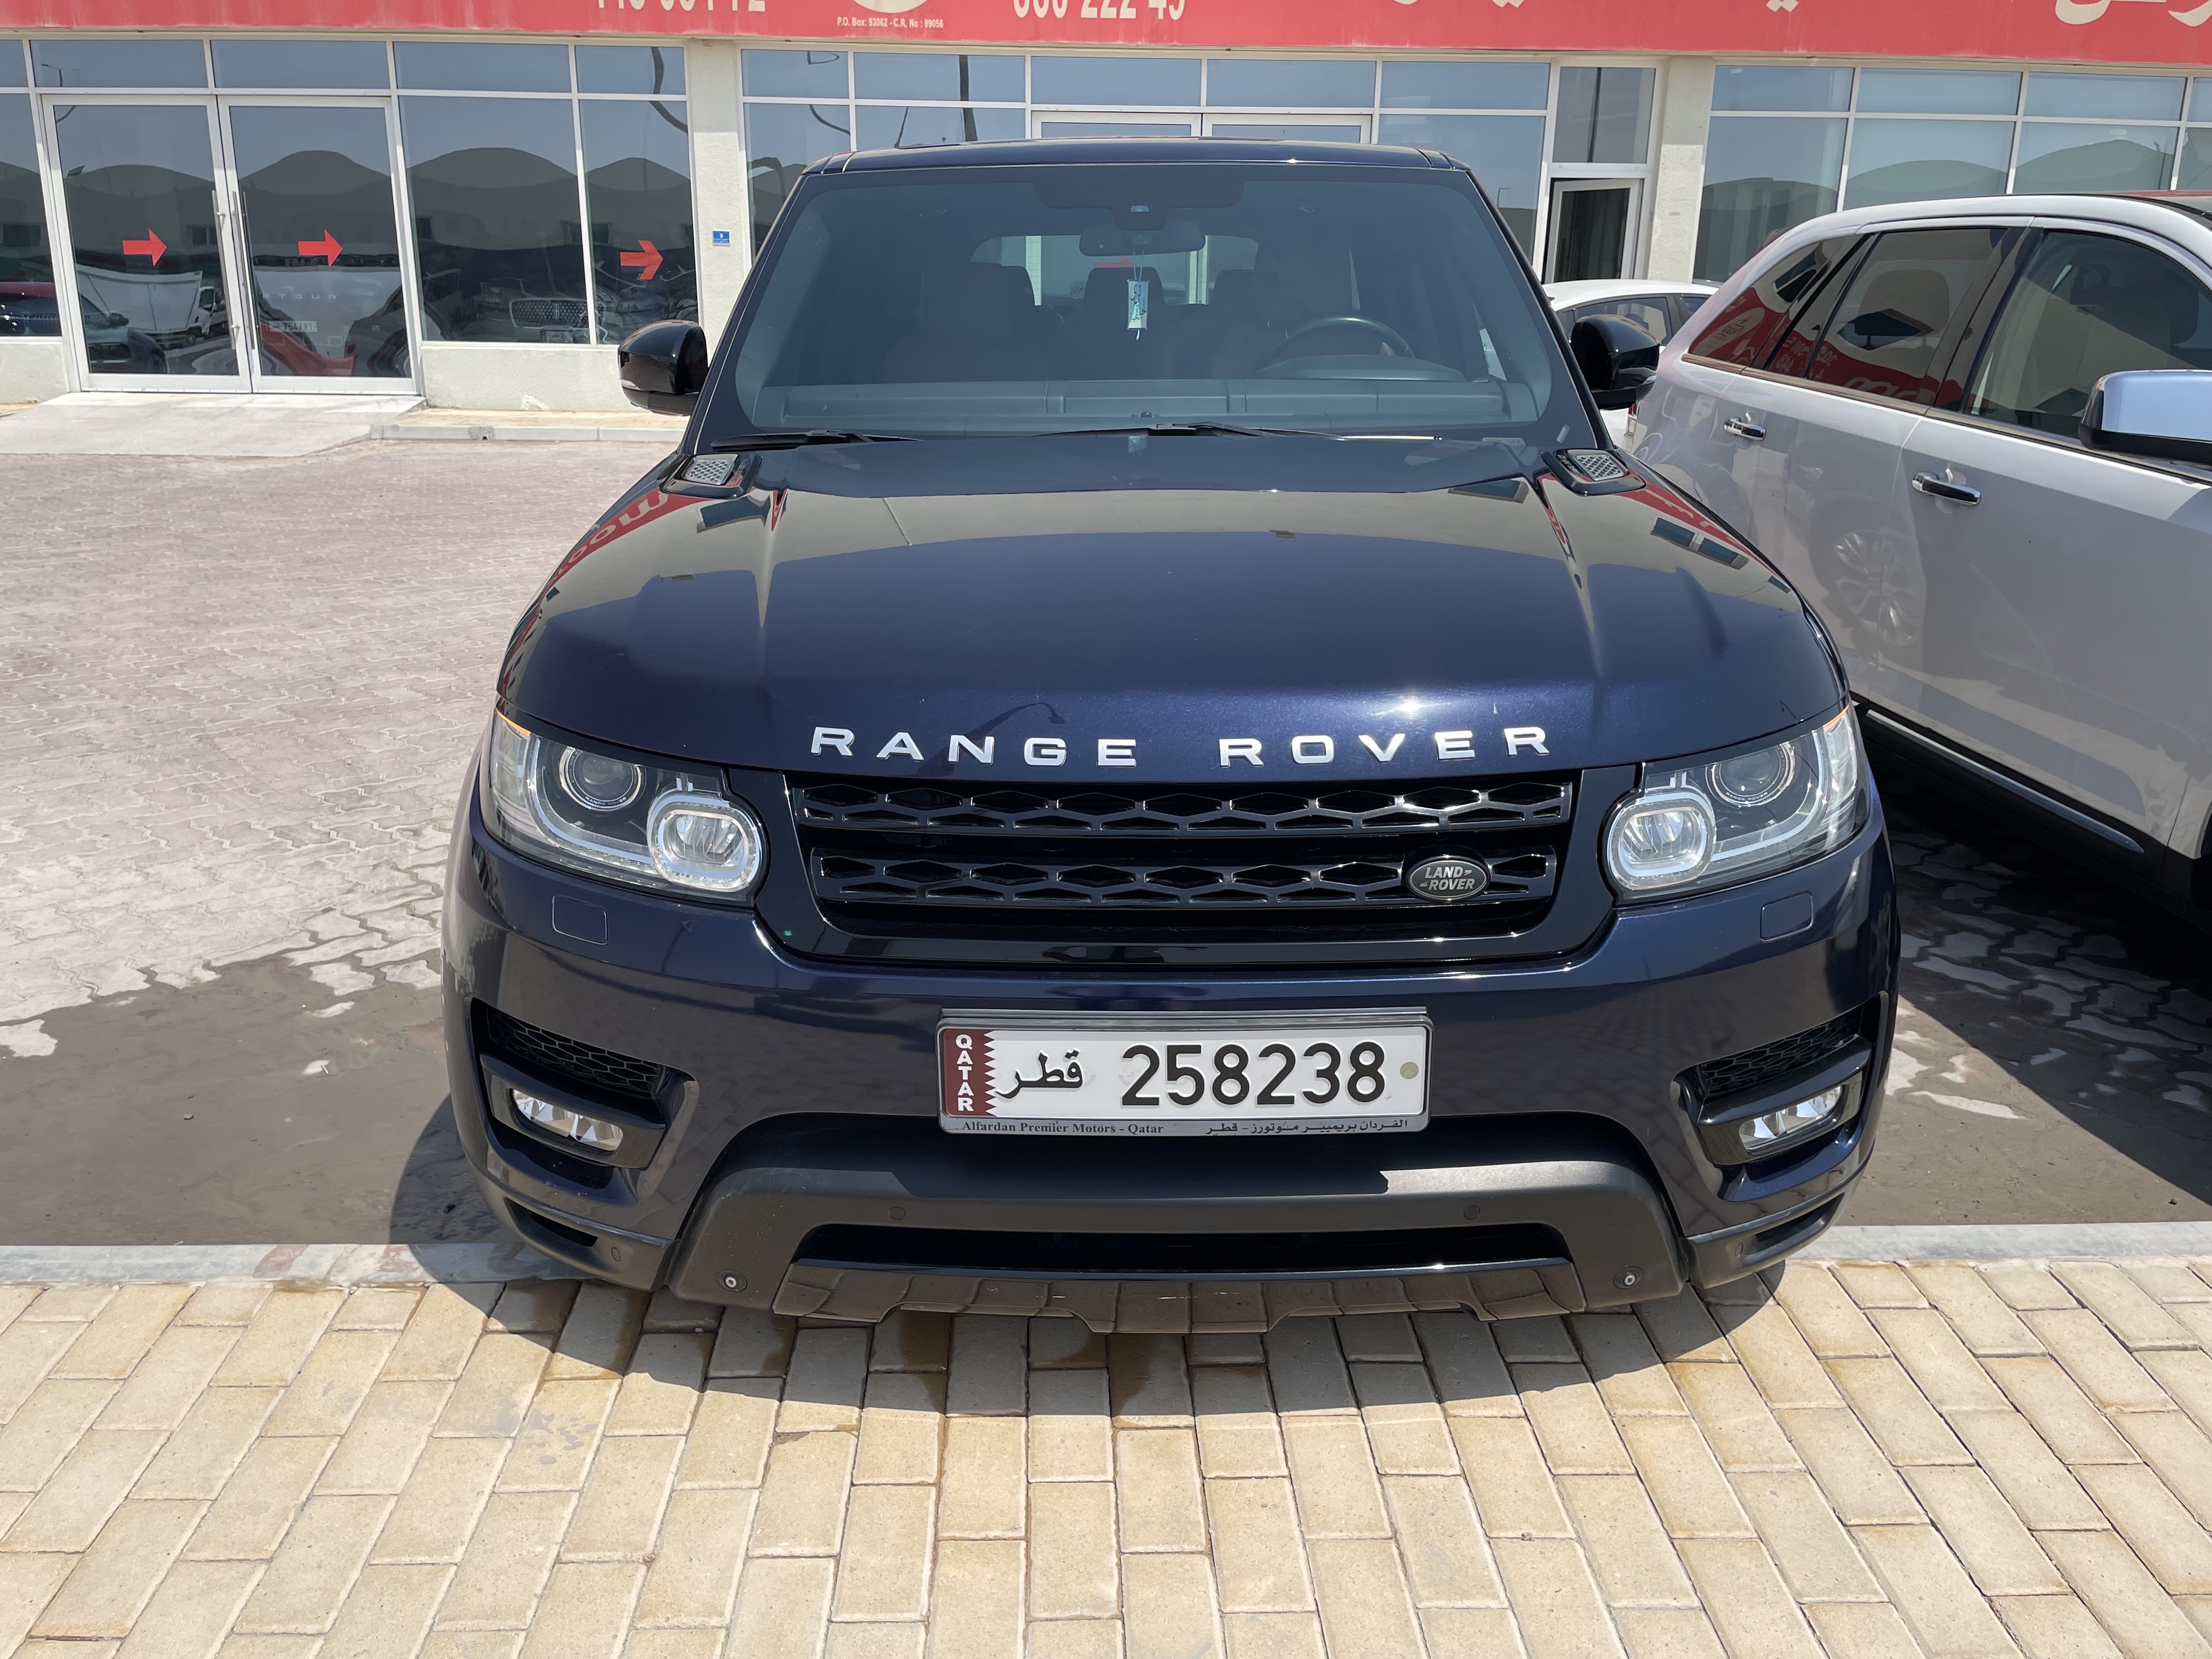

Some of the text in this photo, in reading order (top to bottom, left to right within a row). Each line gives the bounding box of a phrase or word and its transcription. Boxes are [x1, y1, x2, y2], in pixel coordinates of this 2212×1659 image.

[837, 16, 850, 26] P.O.
[868, 18, 888, 27] 93062
[893, 18, 907, 27] C.R.
[924, 19, 944, 28] 99056
[810, 726, 1549, 767] RANGE ROVER
[585, 796, 627, 806] RANGE ROVER
[1725, 792, 1768, 801] RANGE ROVER
[1424, 866, 1464, 878] LAND
[1427, 878, 1475, 890] ROVER
[956, 1034, 974, 1111] QATAR
[995, 1048, 1084, 1099] قطر
[1121, 1040, 1386, 1107] 258238
[962, 1121, 1015, 1132] Alfardan
[1020, 1122, 1069, 1133] Premier
[1072, 1124, 1116, 1133] Motors
[1128, 1124, 1164, 1135] Qatar
[1205, 1122, 1238, 1135] قطر
[1360, 1119, 1408, 1131] الفردان
